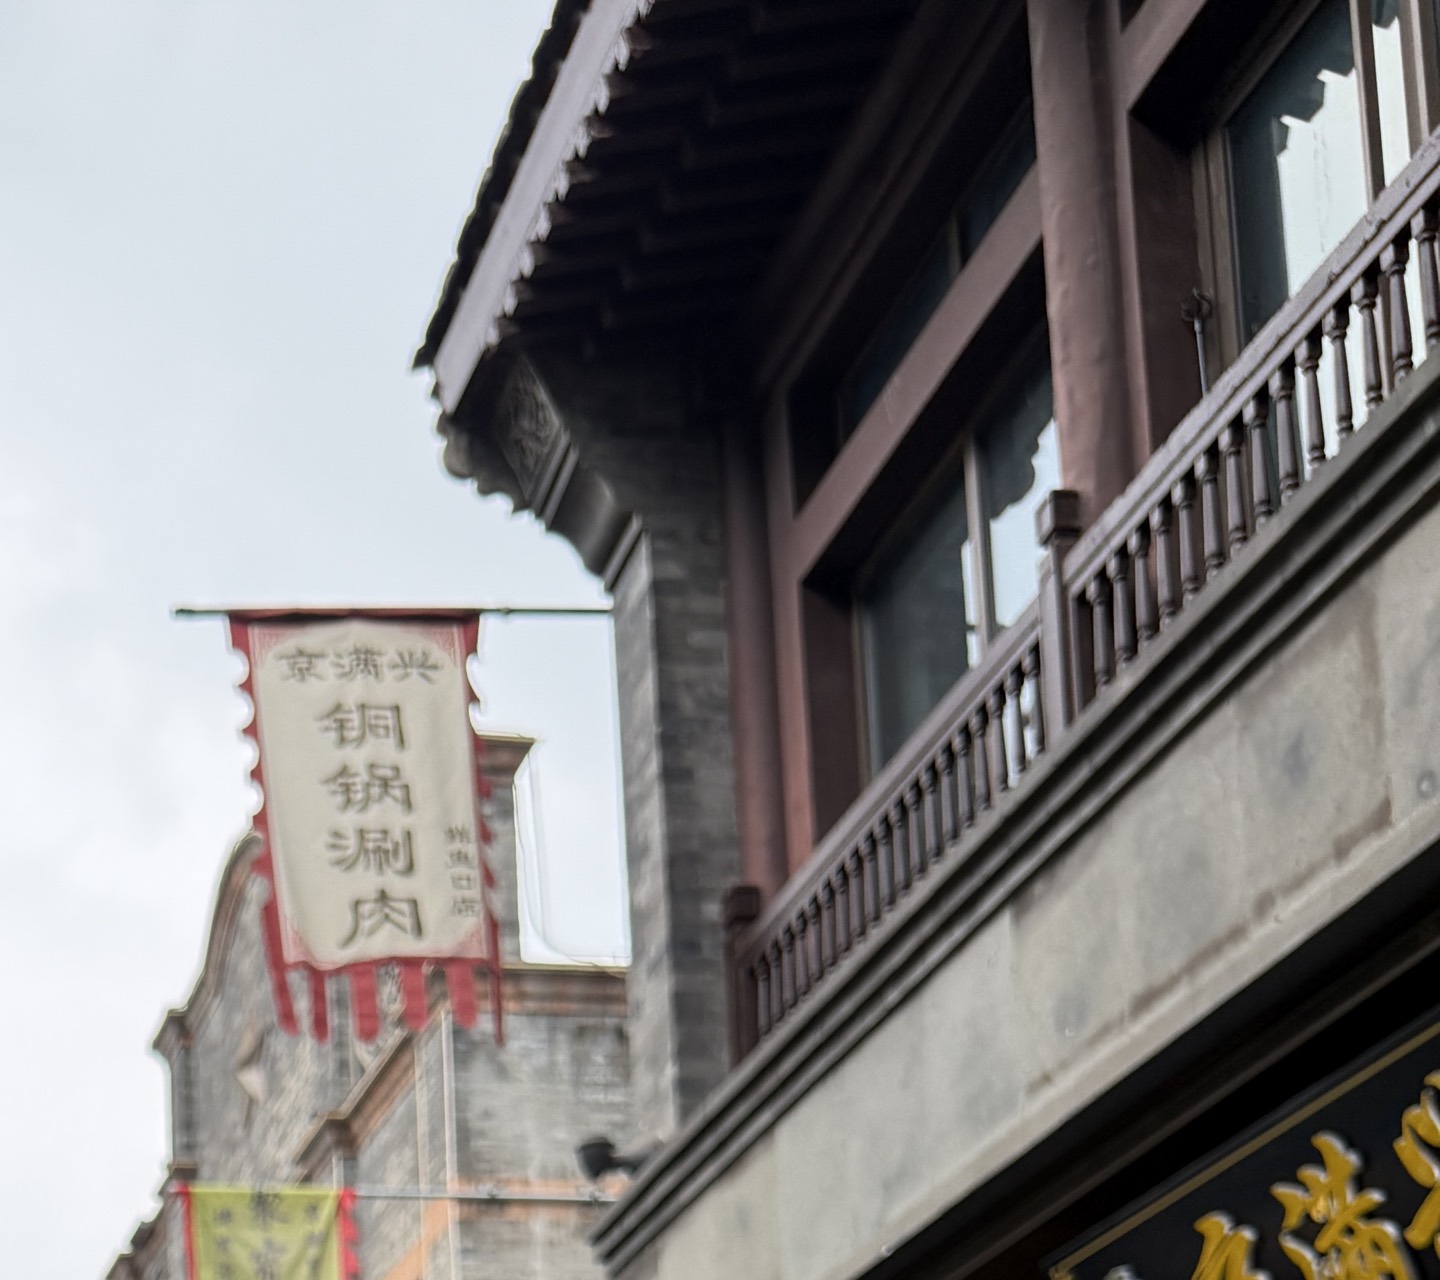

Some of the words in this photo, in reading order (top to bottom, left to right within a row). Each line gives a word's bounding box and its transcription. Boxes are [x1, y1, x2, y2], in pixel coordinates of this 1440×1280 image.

[276, 646, 442, 683] 京满兴
[314, 699, 424, 951] 铜锅涮肉
